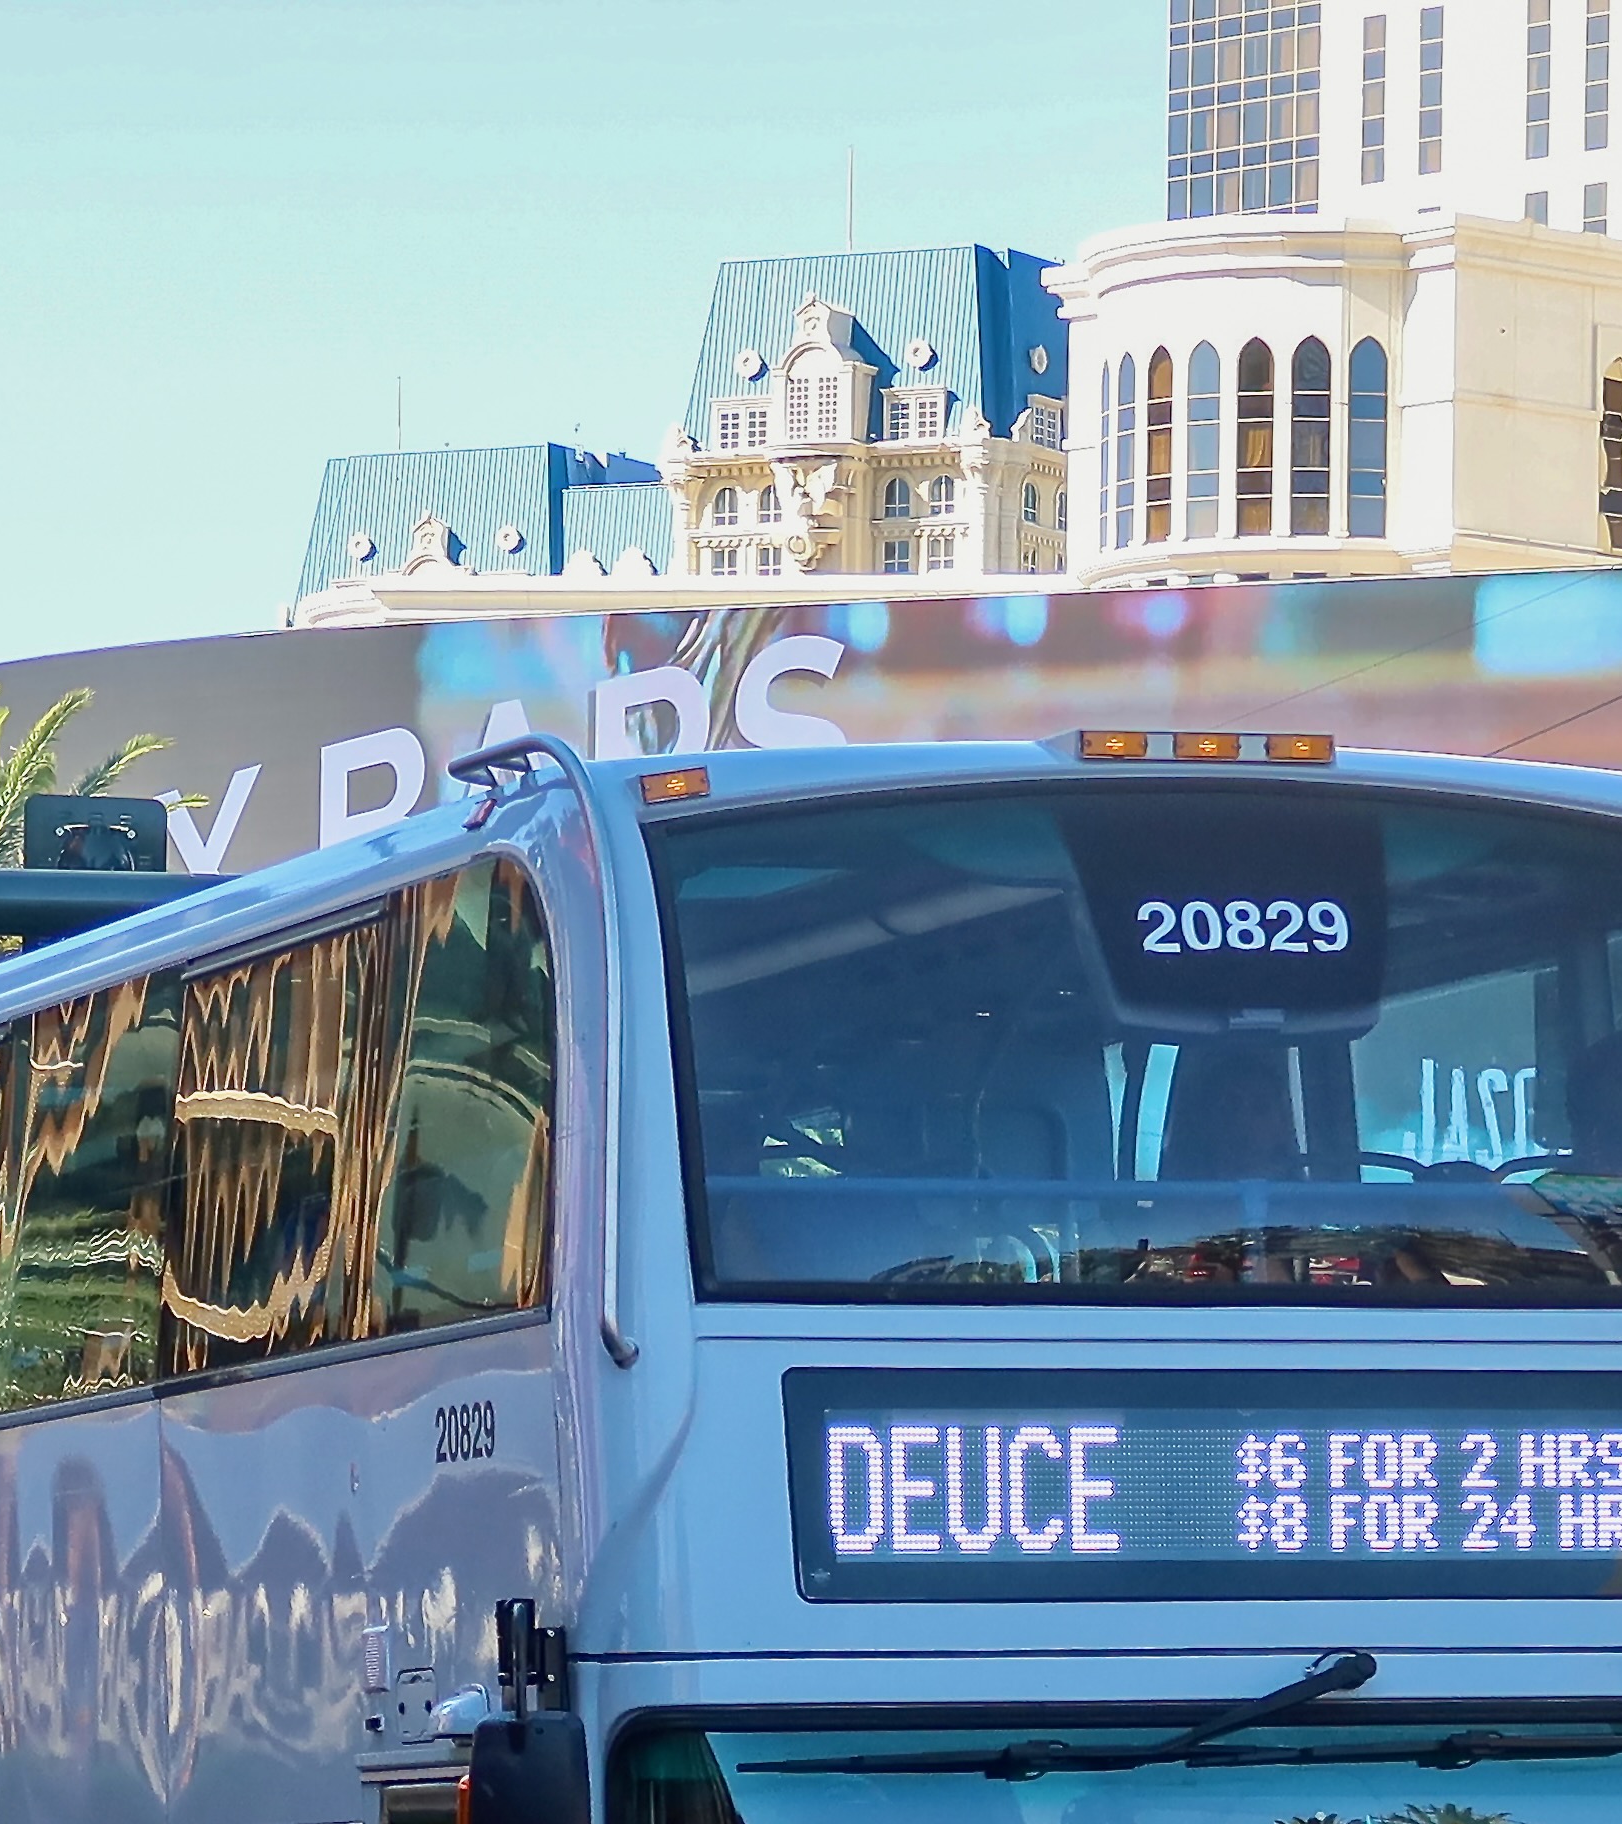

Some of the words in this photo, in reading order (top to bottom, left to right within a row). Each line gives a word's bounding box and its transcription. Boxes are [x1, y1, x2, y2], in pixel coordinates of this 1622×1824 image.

[1136, 899, 1350, 954] 20829
[434, 1400, 496, 1463] 20829
[1235, 1433, 1307, 1489] $6
[1328, 1433, 1440, 1489] FOR
[1460, 1433, 1499, 1489] 2
[824, 1424, 1122, 1556] DEUCE
[1235, 1493, 1310, 1553] $8
[1328, 1493, 1441, 1553] FOR
[1460, 1492, 1537, 1552] 24
